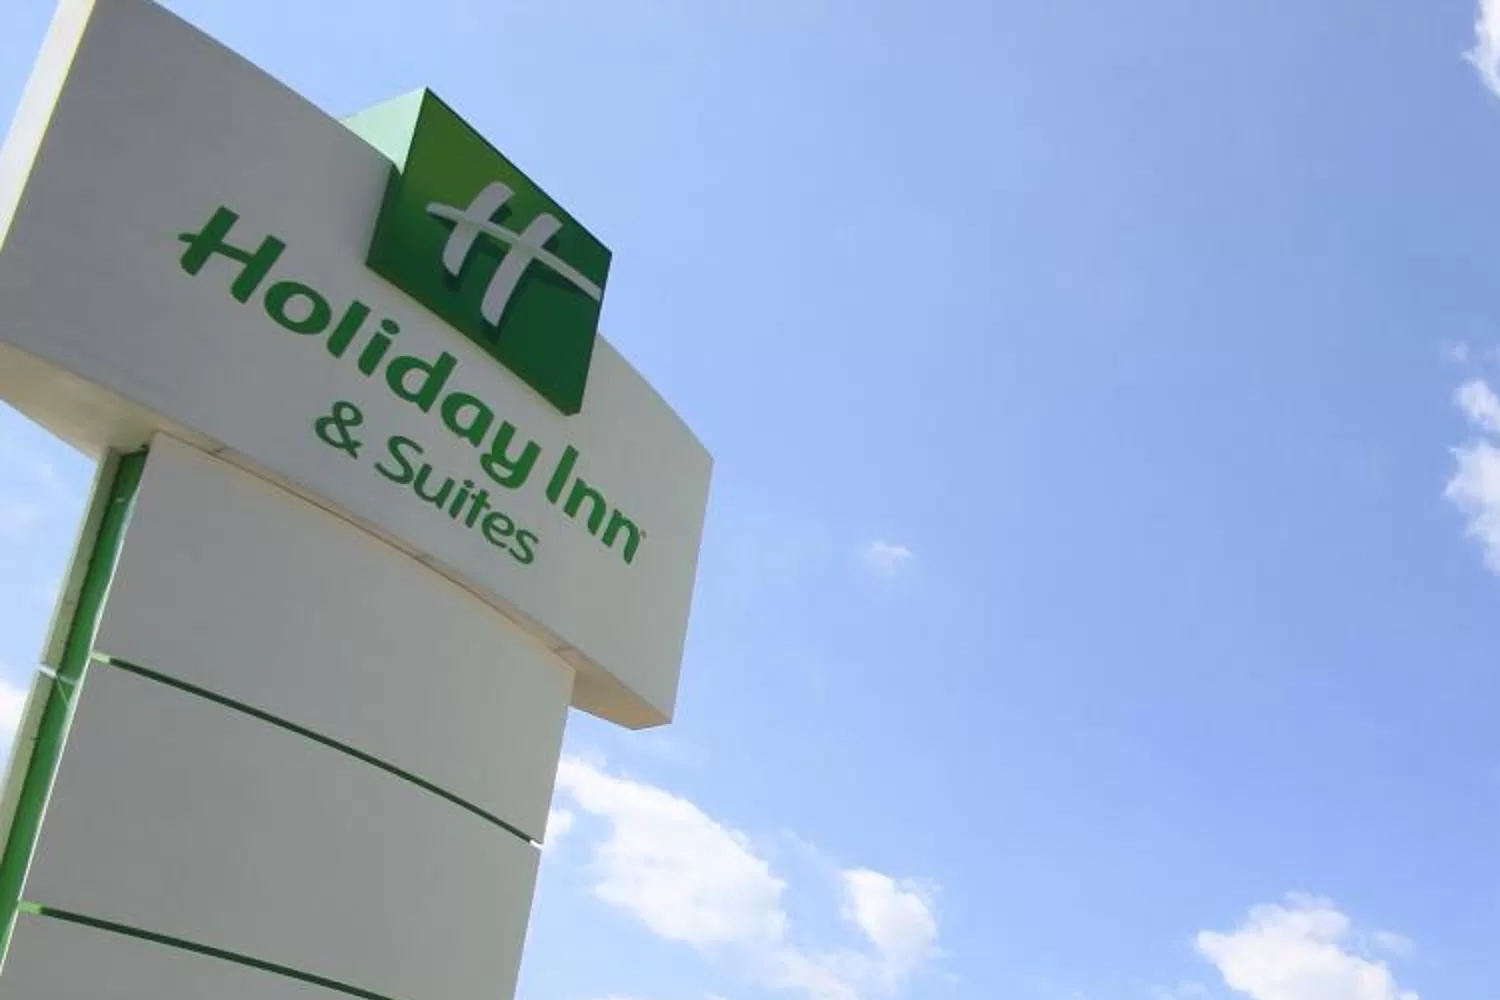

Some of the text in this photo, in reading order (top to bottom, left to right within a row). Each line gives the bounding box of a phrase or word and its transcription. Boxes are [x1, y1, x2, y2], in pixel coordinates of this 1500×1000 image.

[177, 205, 640, 564] Holiday Inn
[314, 400, 539, 565] & Suites
